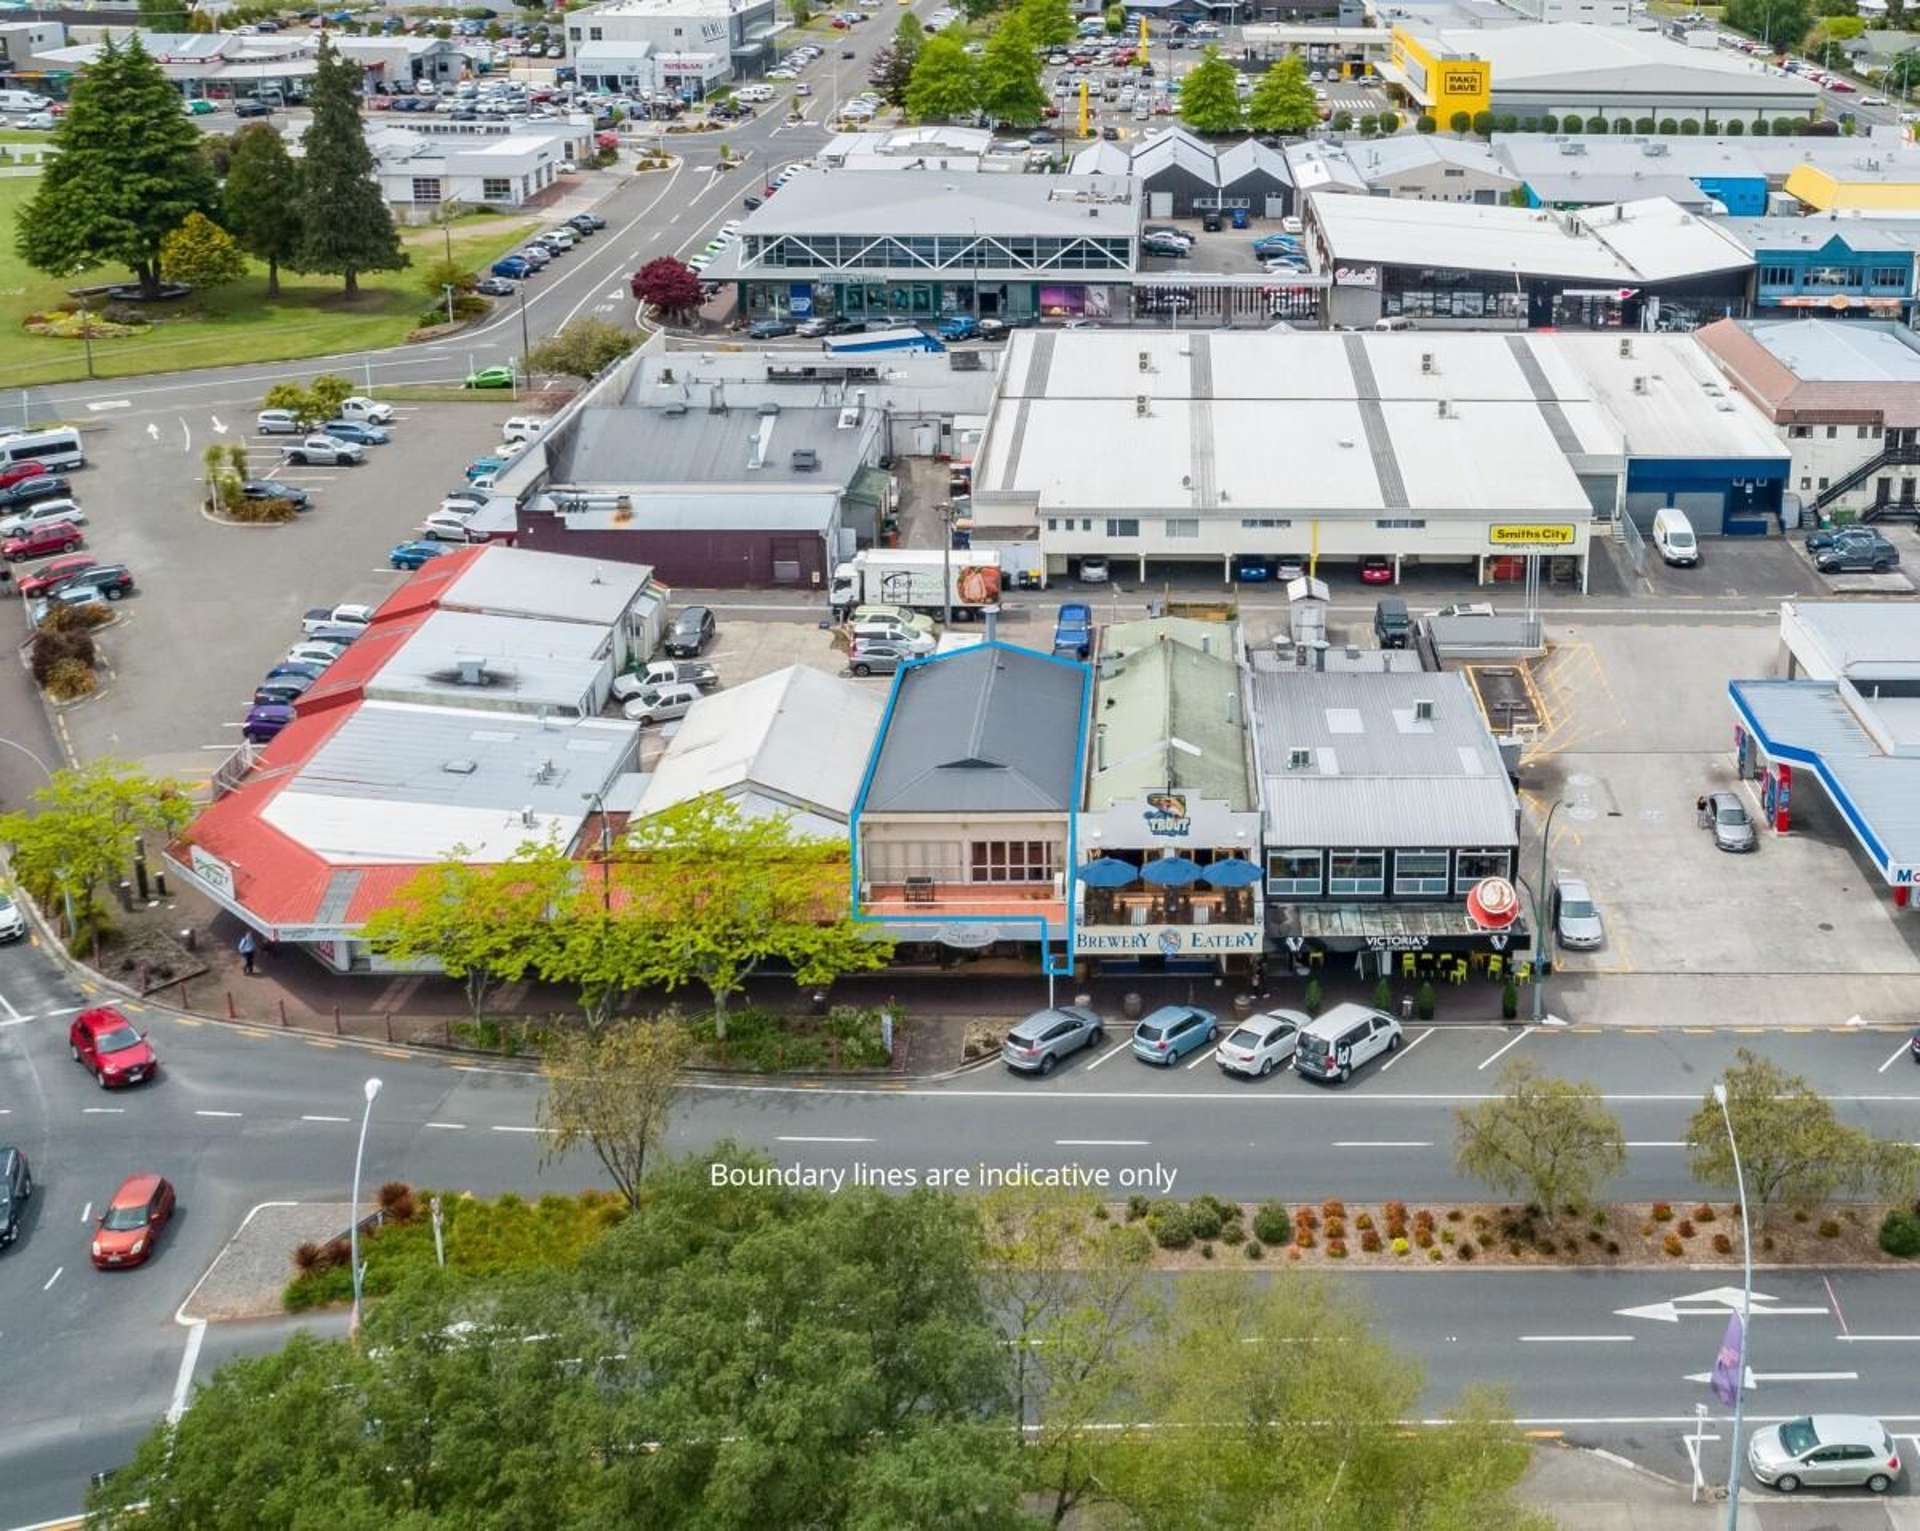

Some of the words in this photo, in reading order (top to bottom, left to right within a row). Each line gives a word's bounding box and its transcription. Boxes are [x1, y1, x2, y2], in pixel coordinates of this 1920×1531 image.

[1497, 529, 1540, 539] Smiths
[1542, 529, 1567, 541] City
[1077, 932, 1150, 948] BREWERY
[1190, 932, 1258, 948] EATERY
[1366, 936, 1429, 945] VICTORIA'S
